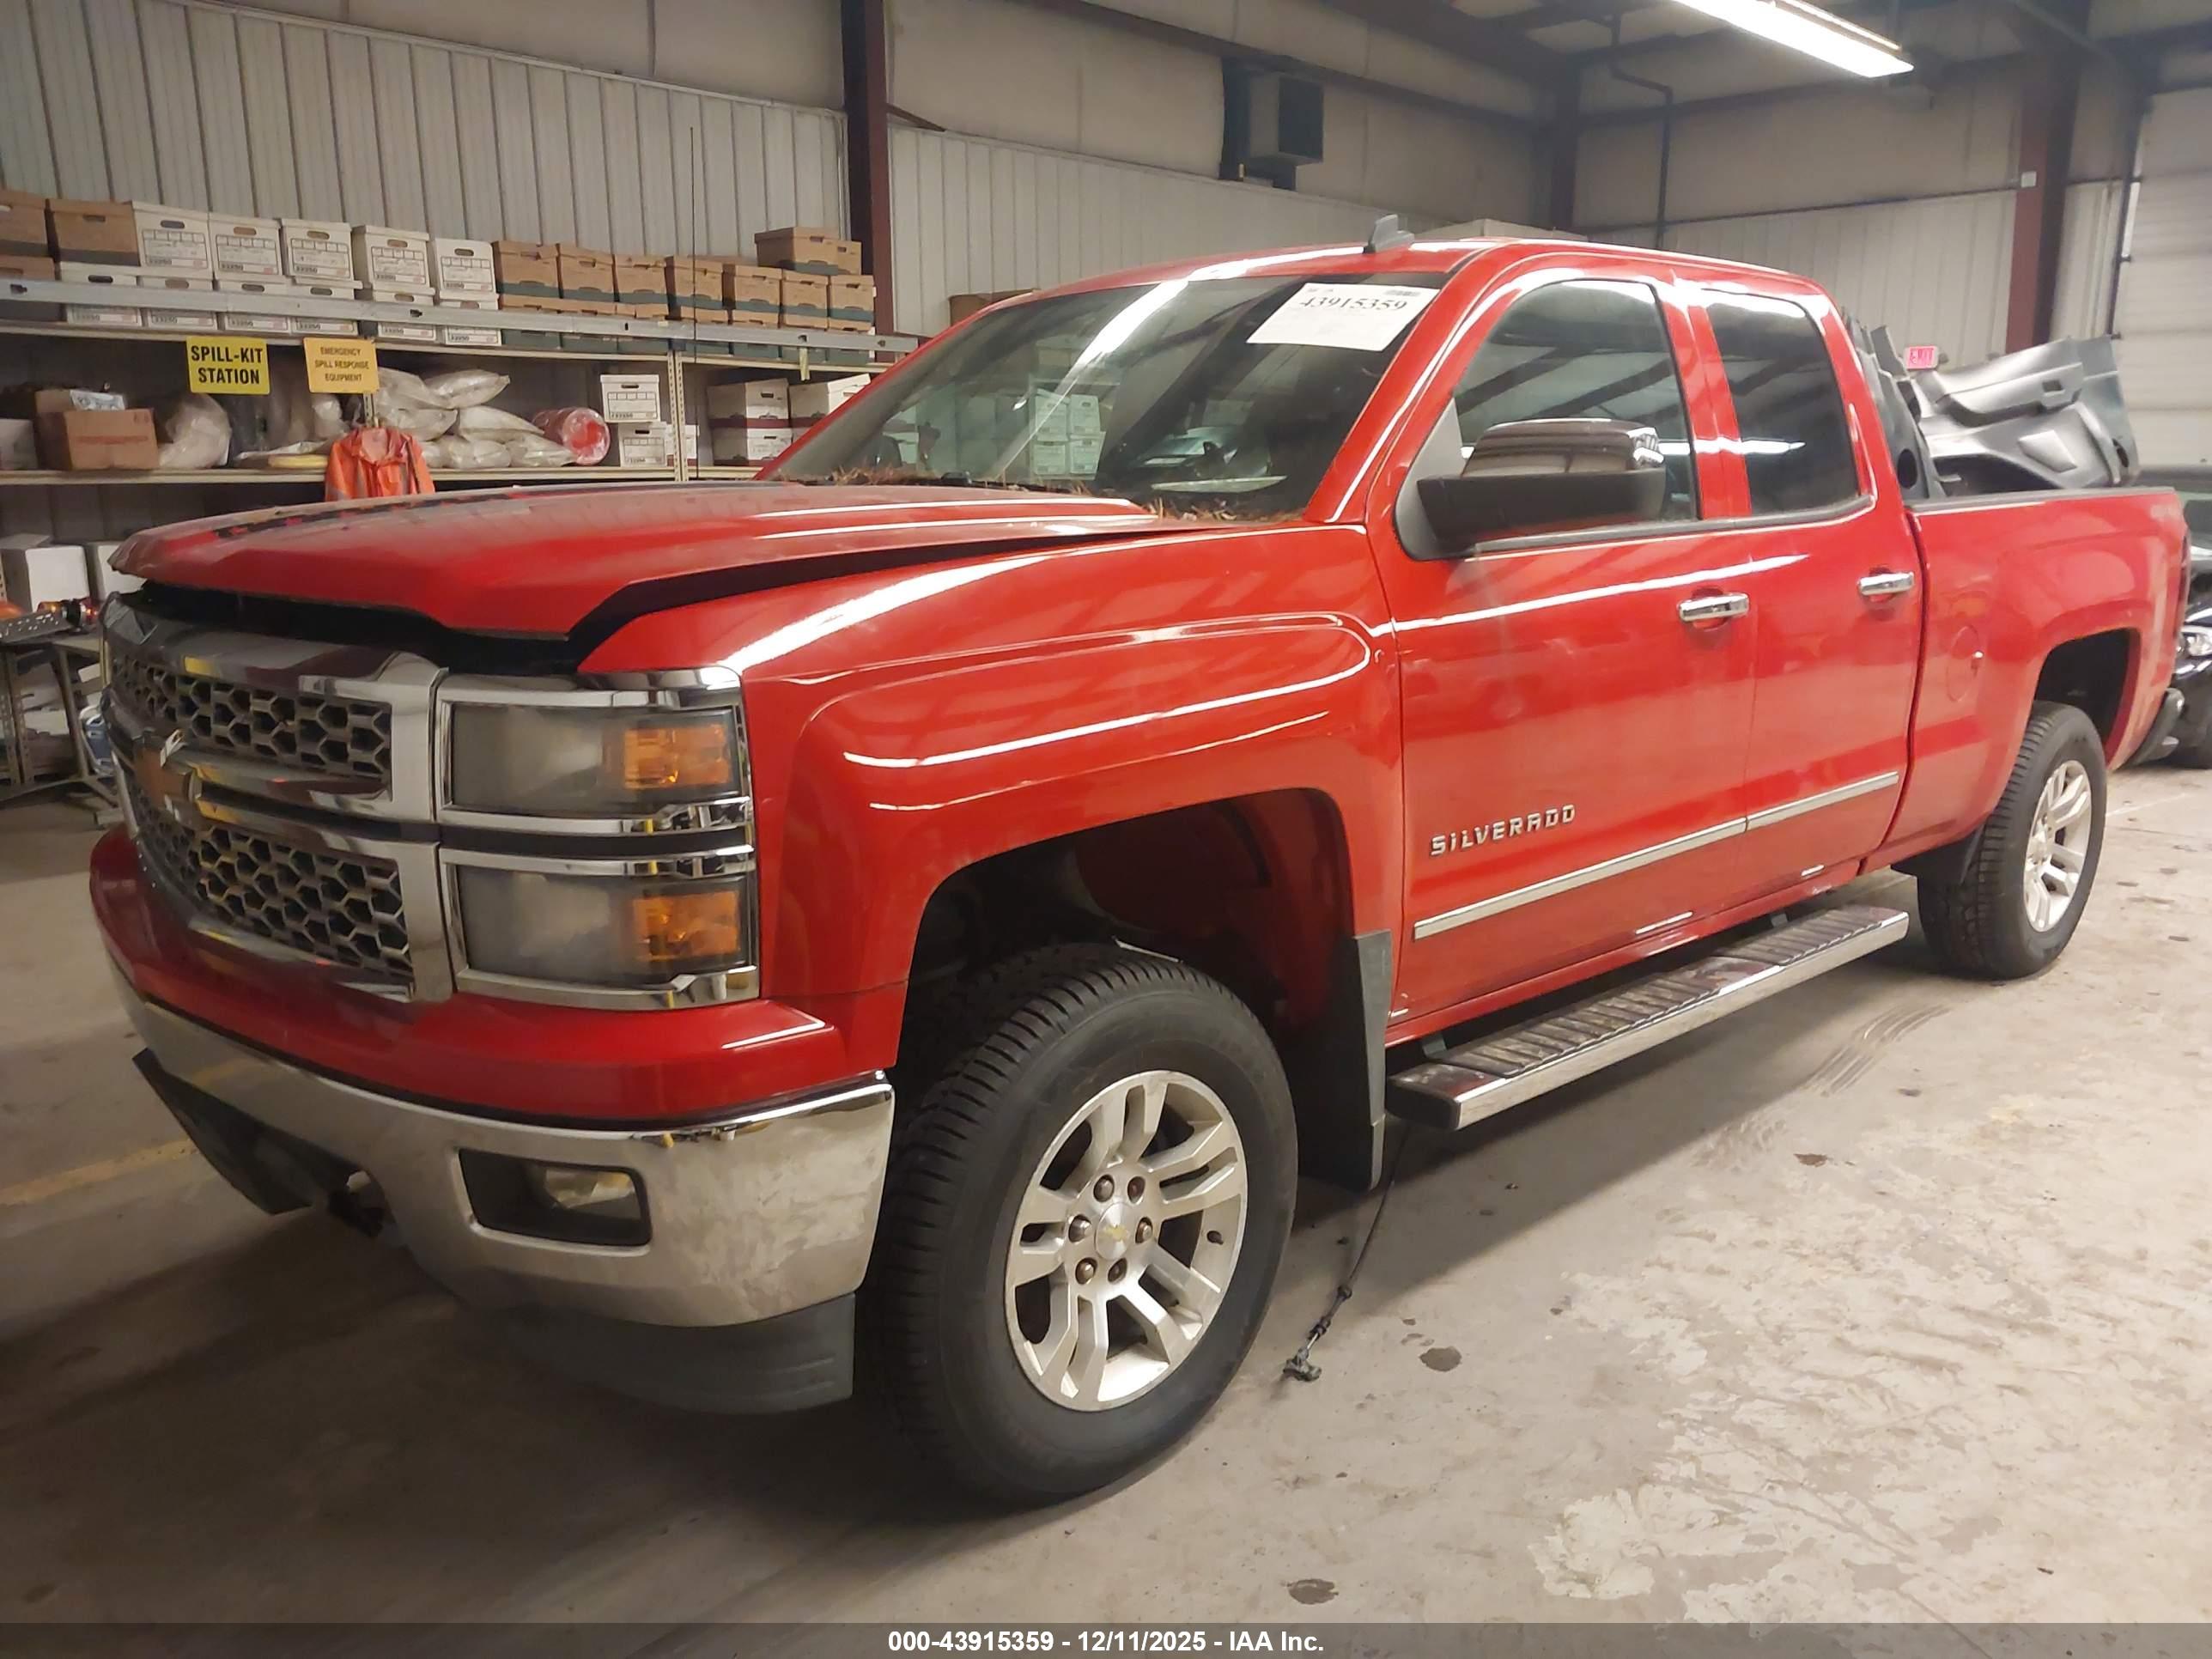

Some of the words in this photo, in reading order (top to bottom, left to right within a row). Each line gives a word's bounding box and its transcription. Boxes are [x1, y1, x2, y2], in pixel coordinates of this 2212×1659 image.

[1299, 296, 1407, 310] 43915359
[191, 345, 264, 363] SPILL-KIT
[320, 347, 361, 356] EMERGENCY
[314, 360, 333, 368] SPILL
[334, 361, 369, 369] RESPONSE
[198, 368, 259, 384] STATION
[1430, 804, 1577, 856] SILVERADO
